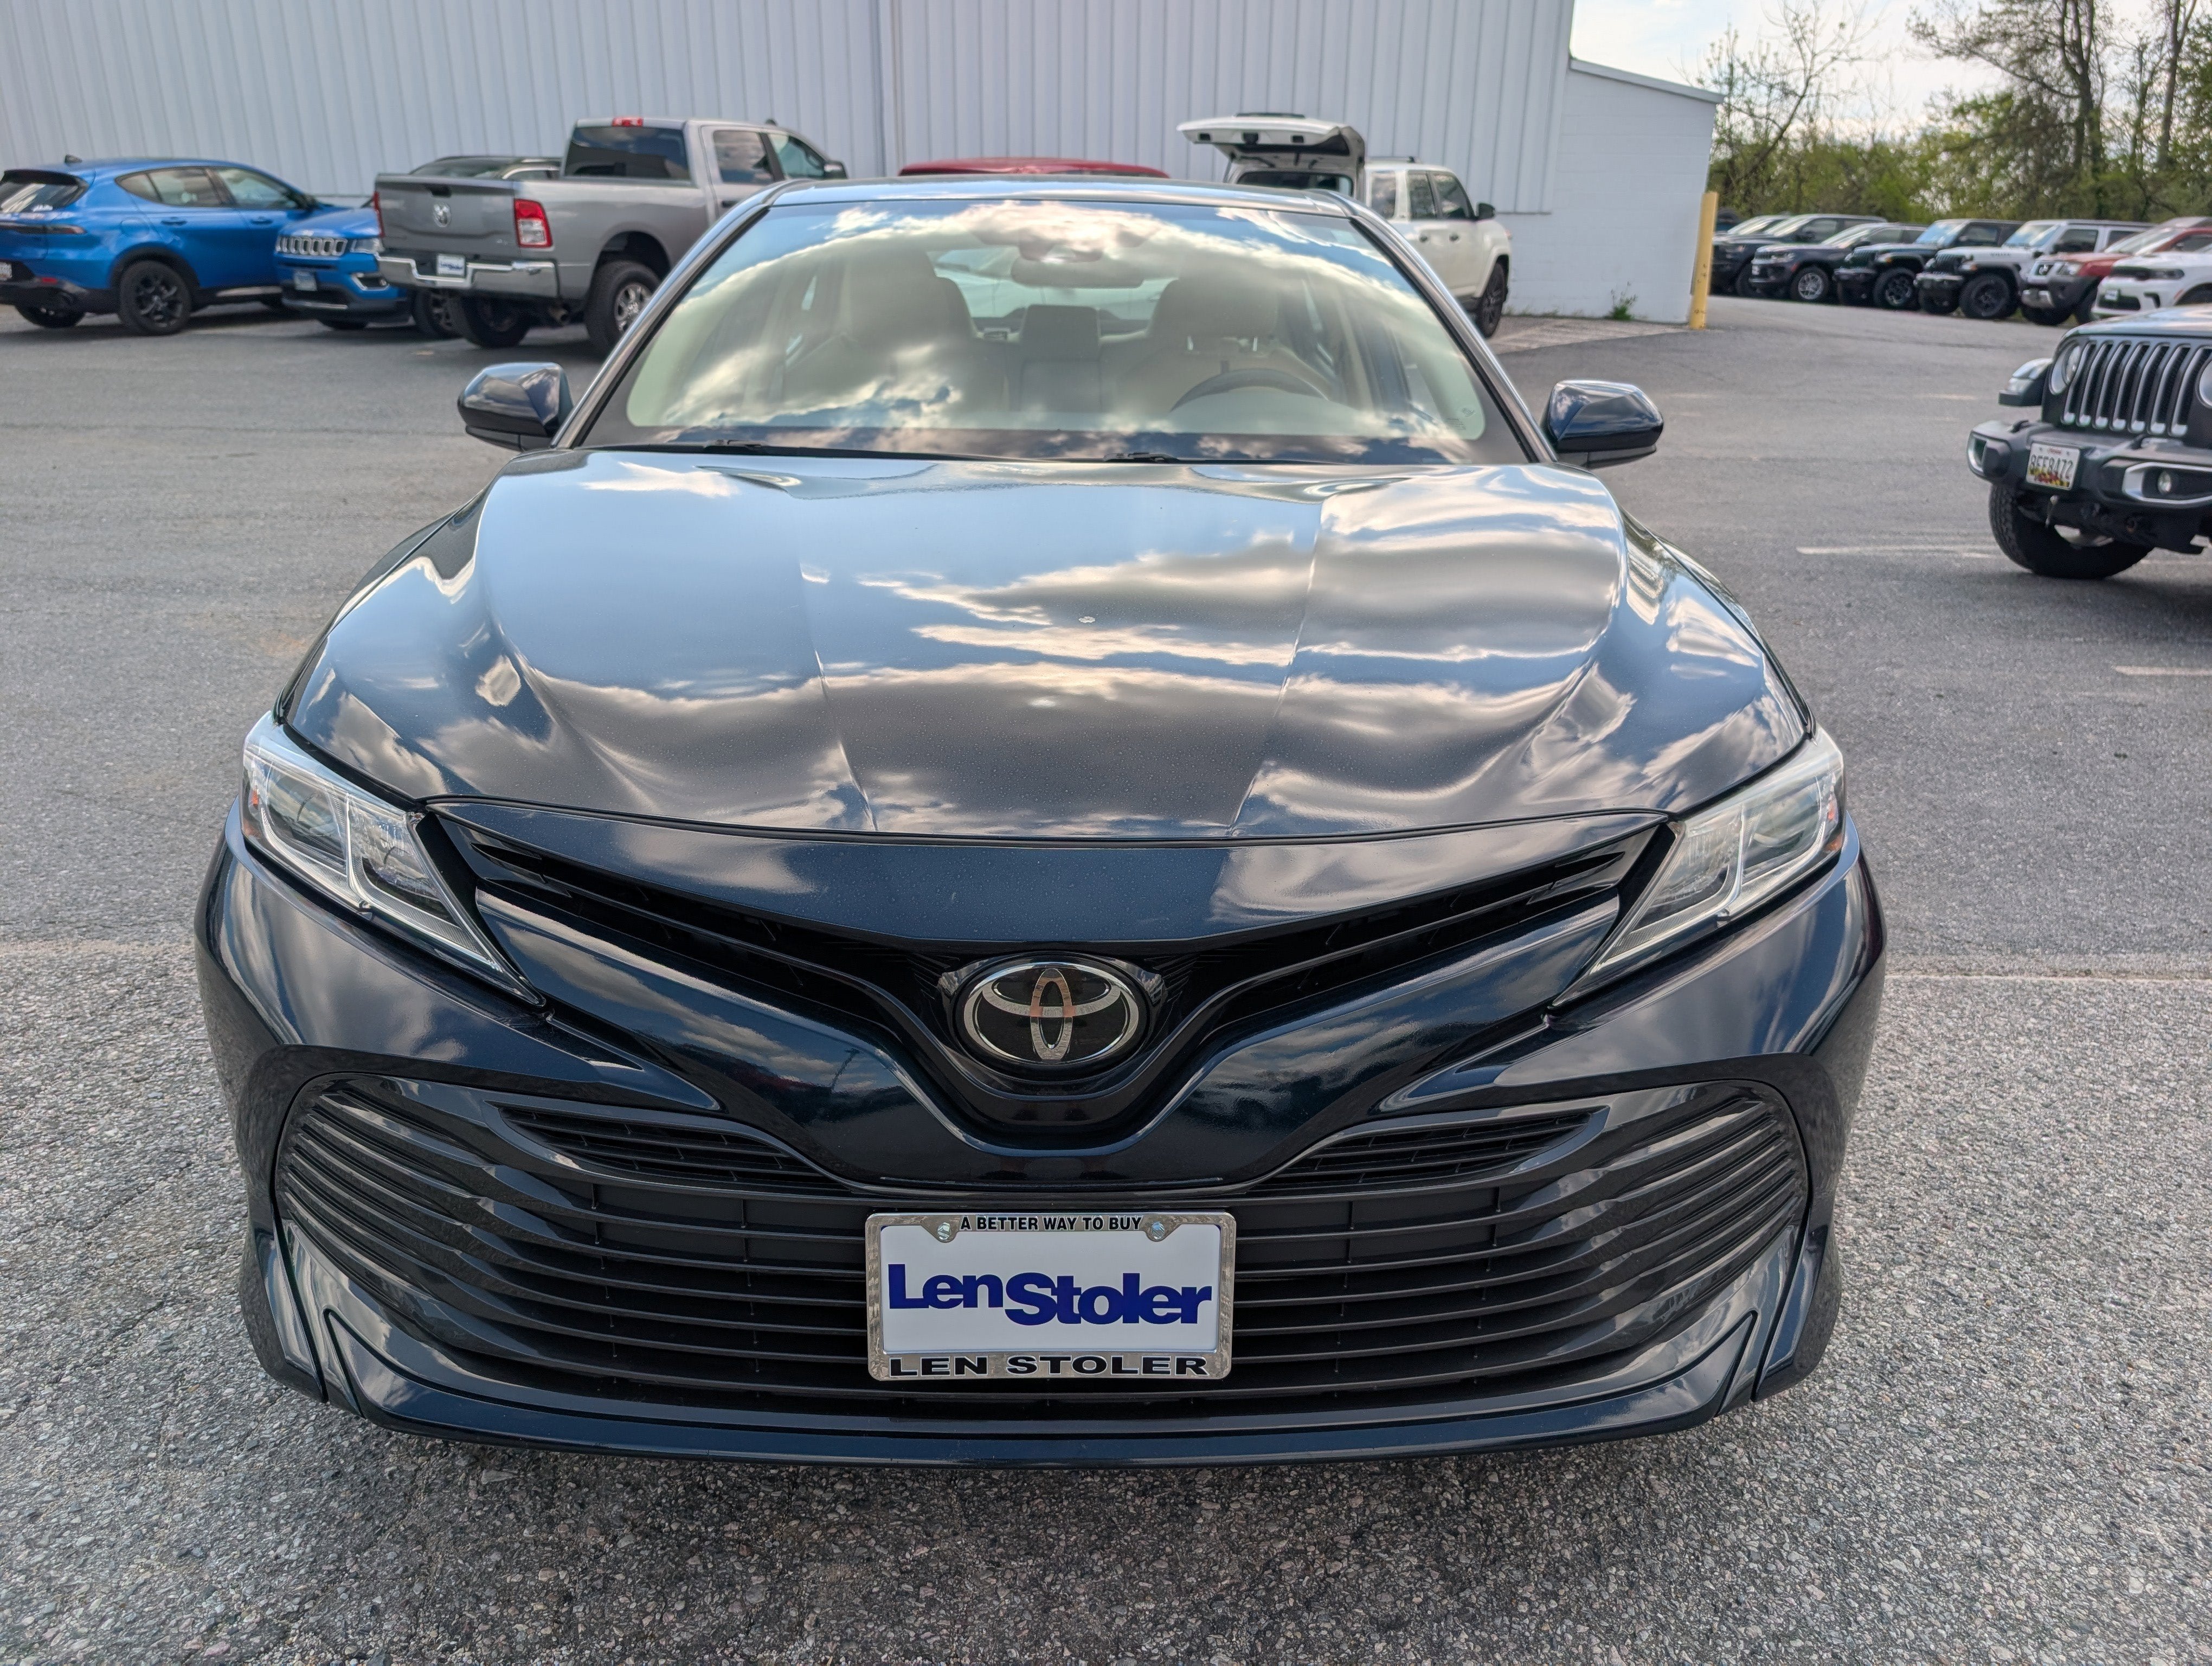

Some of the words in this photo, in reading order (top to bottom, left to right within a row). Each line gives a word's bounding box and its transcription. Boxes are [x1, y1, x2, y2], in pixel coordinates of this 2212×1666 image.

[960, 1216, 972, 1230] A
[976, 1216, 1038, 1230] BETTER
[1043, 1216, 1078, 1230] WAY
[1082, 1215, 1104, 1230] TO
[1109, 1215, 1143, 1230] BUY
[889, 1356, 988, 1377] LEN
[1006, 1356, 1210, 1376] STOLER
